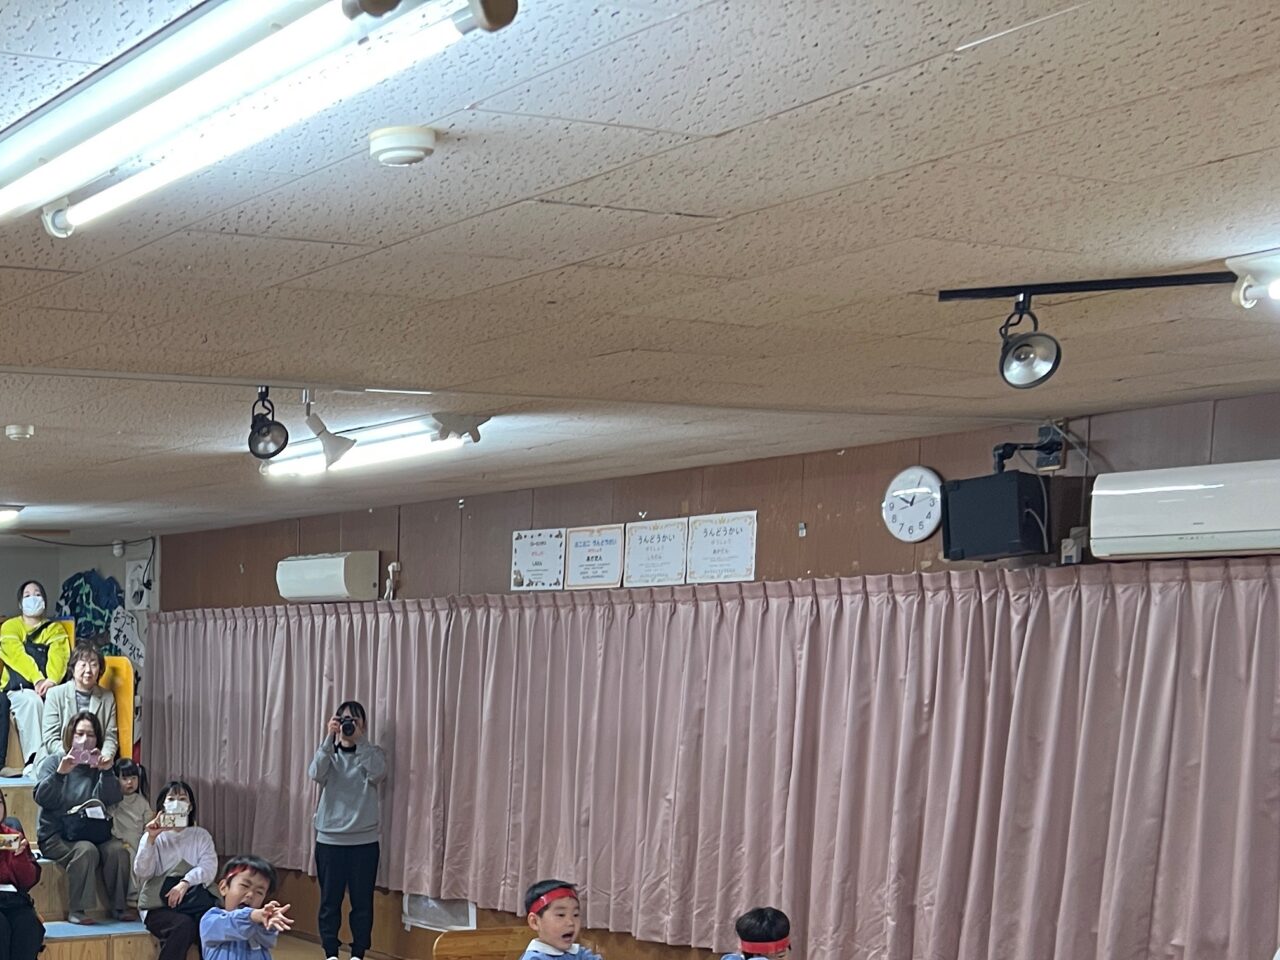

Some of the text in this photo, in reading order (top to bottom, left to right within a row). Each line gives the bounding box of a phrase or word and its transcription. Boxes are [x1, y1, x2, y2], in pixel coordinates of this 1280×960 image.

[703, 527, 743, 538] うんどうかい
[639, 534, 675, 544] うんどうかい
